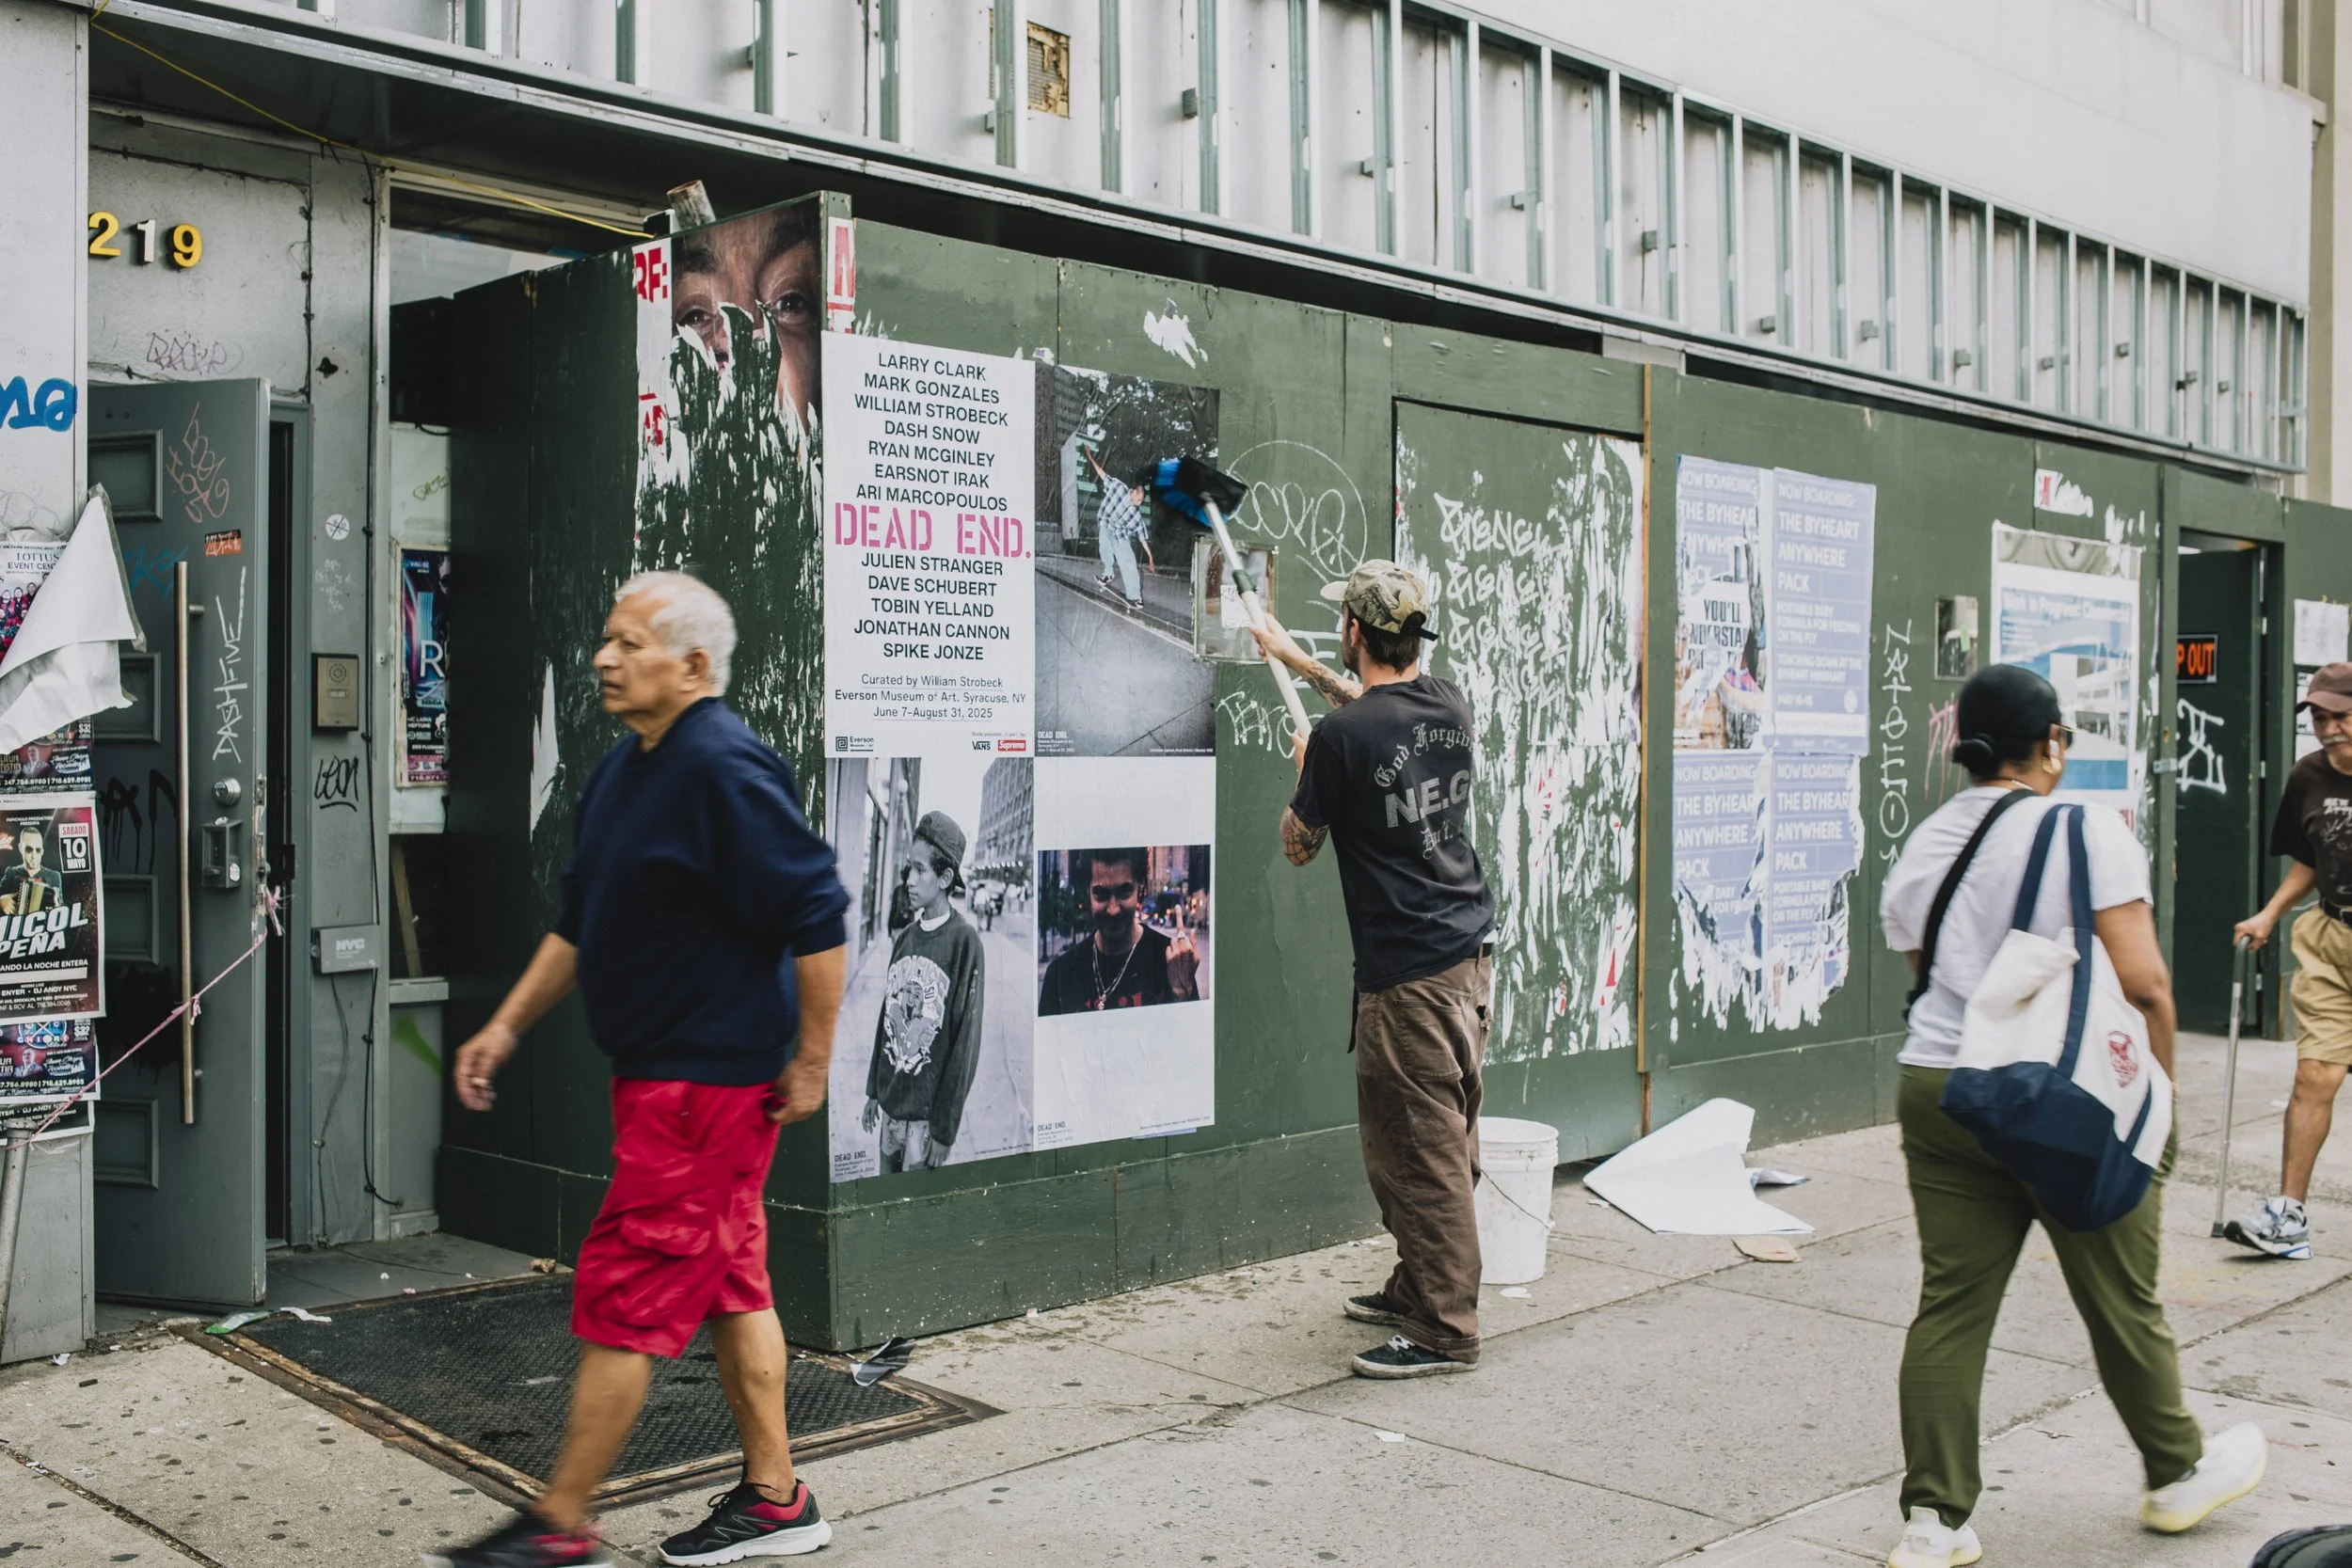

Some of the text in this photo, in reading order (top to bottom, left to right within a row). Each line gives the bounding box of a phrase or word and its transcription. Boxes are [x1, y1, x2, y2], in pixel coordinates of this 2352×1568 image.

[88, 212, 203, 268] 219
[879, 353, 986, 381] LARRY CLARK
[865, 372, 999, 404] MARK GONZALES
[854, 393, 1009, 426] WILLIAM STROBECK
[884, 420, 980, 444] DASH SNOW
[868, 440, 994, 467] RYAN MCGINLEY
[875, 464, 989, 488] EARSNOT IRAK
[856, 483, 1008, 511] ARI MARCOPOULOS
[1778, 483, 1801, 499] NOW
[1680, 500, 1757, 527] THE BYHEAR
[834, 502, 1031, 559] DEAD END.
[1778, 511, 1859, 539] THE BYHEART
[861, 552, 1003, 576] JULIEN STRANGER
[1777, 542, 1846, 566] ANYWHERE
[8, 562, 37, 570] EVENT
[868, 575, 997, 596] DAVE SCHUBERT
[1777, 571, 1810, 593] PACK
[871, 597, 993, 618] TOBIN YELLAND
[854, 619, 1009, 640] JONATHAN CANNON
[883, 642, 984, 660] SPIKE JONZE
[2187, 642, 2216, 675] OUT
[861, 673, 1003, 689] Curated by William Strobeck
[834, 689, 878, 701] Everson
[881, 690, 925, 702] Museum
[928, 691, 937, 702] of
[962, 692, 1009, 705] Syracuse,
[1012, 693, 1026, 704] NY
[873, 706, 898, 718] June
[967, 708, 993, 718] 2025
[972, 741, 991, 751] VANS
[999, 740, 1025, 752] Supreme
[1375, 743, 1410, 787] God
[1675, 765, 1701, 782] NOW
[1777, 764, 1801, 780] NOW
[1677, 793, 1754, 816] THE BYHEAR
[1777, 792, 1851, 810] THE BYHEAR
[62, 826, 87, 835] SABADO
[1676, 824, 1748, 847] ANYWHERE
[1775, 821, 1842, 841] ANYWHERE
[63, 837, 87, 858] 10
[67, 858, 87, 869] MAYO
[1676, 858, 1710, 879] PACK
[1775, 851, 1807, 870] PACK
[34, 960, 60, 969] NOCHE
[61, 958, 88, 968] ENTERA
[32, 1104, 52, 1113] ANDY
[834, 1152, 851, 1163] DEAD
